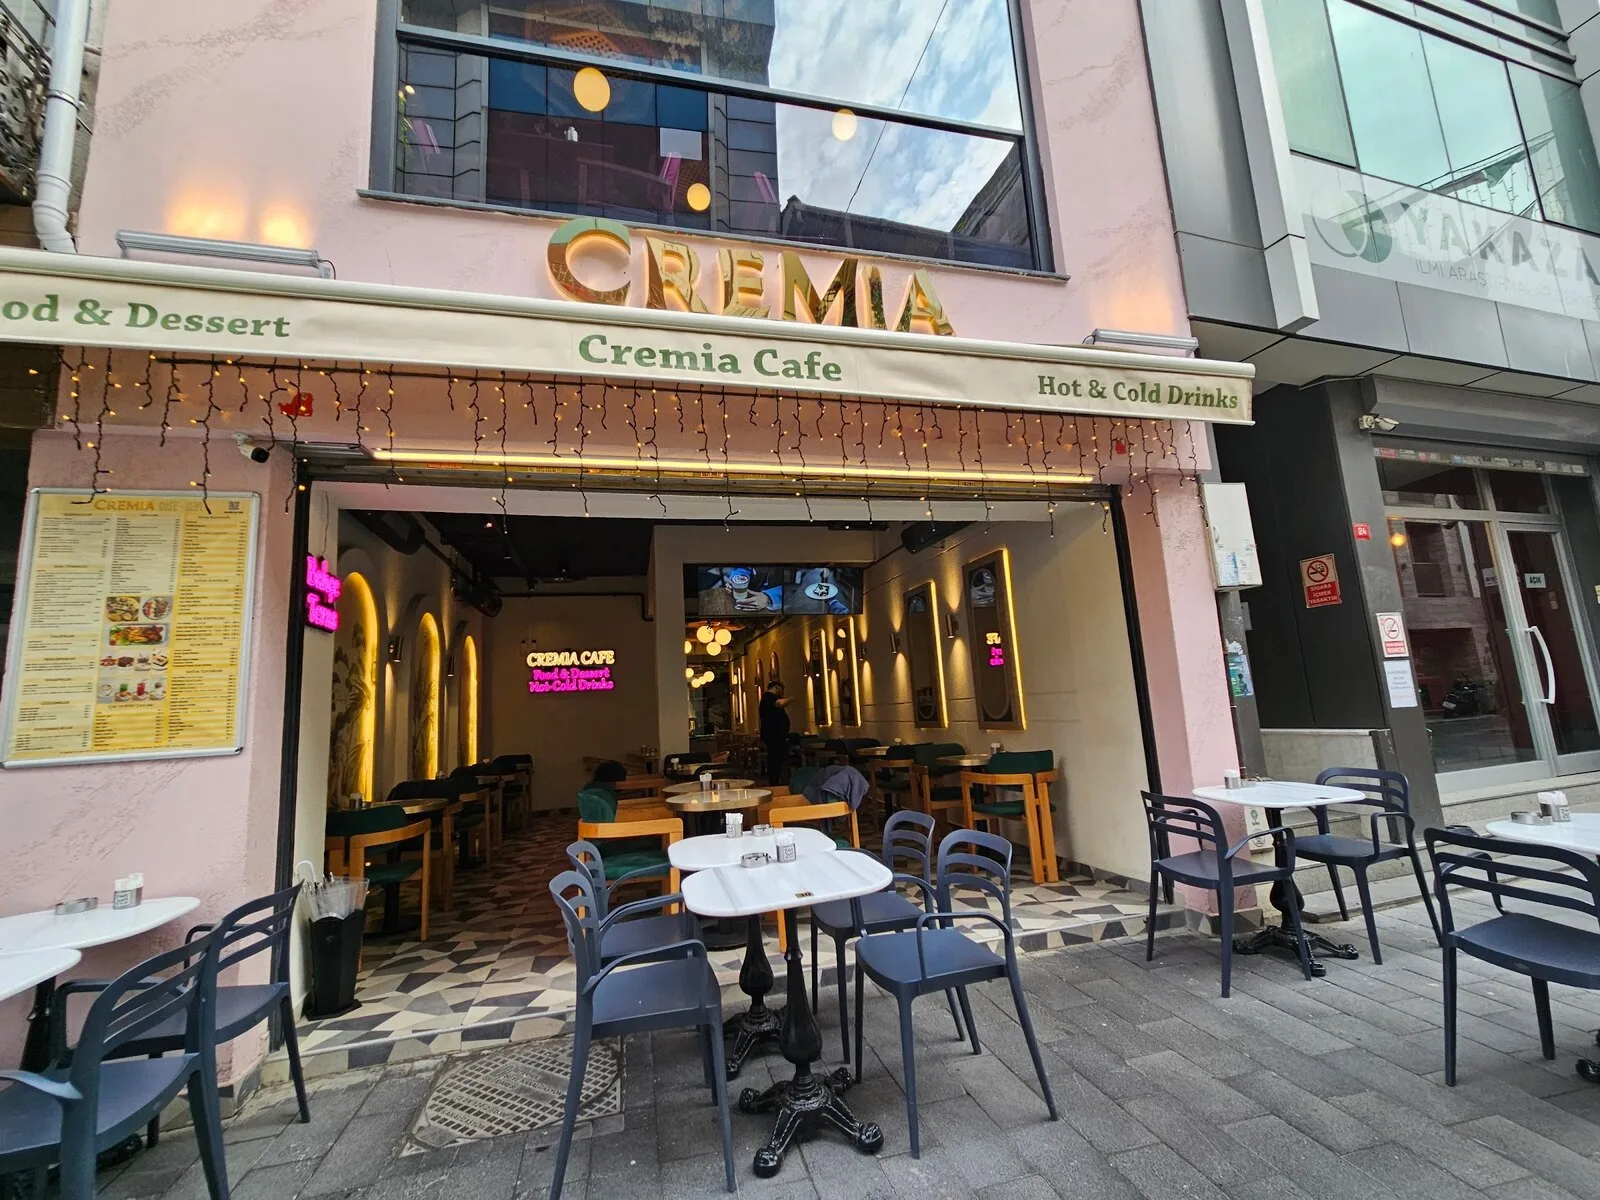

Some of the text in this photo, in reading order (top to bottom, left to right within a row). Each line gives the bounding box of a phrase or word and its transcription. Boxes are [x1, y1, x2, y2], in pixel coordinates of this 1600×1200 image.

[547, 218, 956, 336] CREMIA
[74, 299, 111, 326] &
[125, 302, 290, 338] Dessert
[579, 334, 841, 381] Cremia Cafe
[1038, 374, 1239, 409] Hot & Cold Drinks
[94, 499, 155, 511] CREMIA
[1357, 526, 1368, 536] 24
[526, 650, 615, 667] CREMIA CAFE
